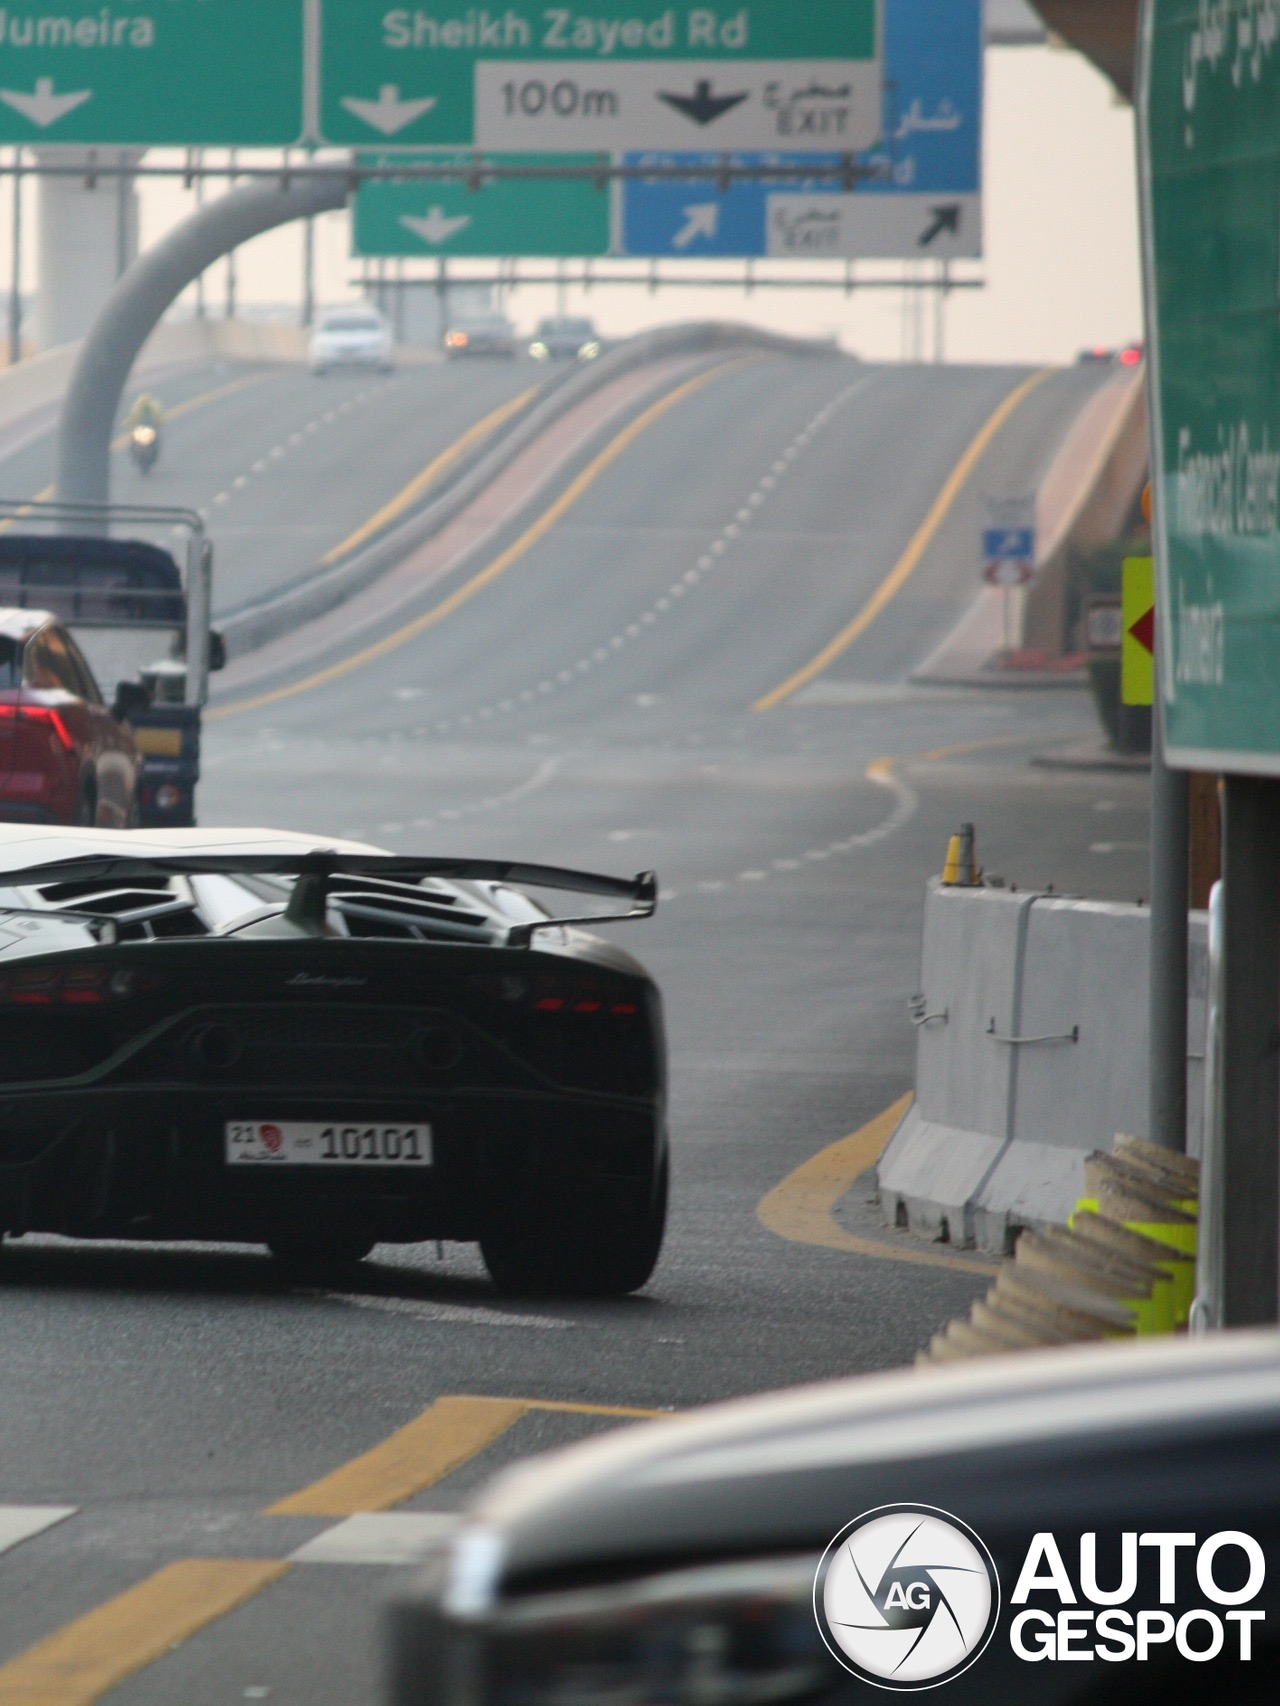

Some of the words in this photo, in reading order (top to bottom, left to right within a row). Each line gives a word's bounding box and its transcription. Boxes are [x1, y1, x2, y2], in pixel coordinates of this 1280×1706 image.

[382, 9, 531, 49] Sheikh
[542, 9, 674, 54] Zayed
[688, 9, 748, 48] Rd
[501, 79, 618, 117] 100m
[776, 107, 849, 136] EXIT
[232, 1126, 255, 1143] 21
[321, 1127, 423, 1160] 10101
